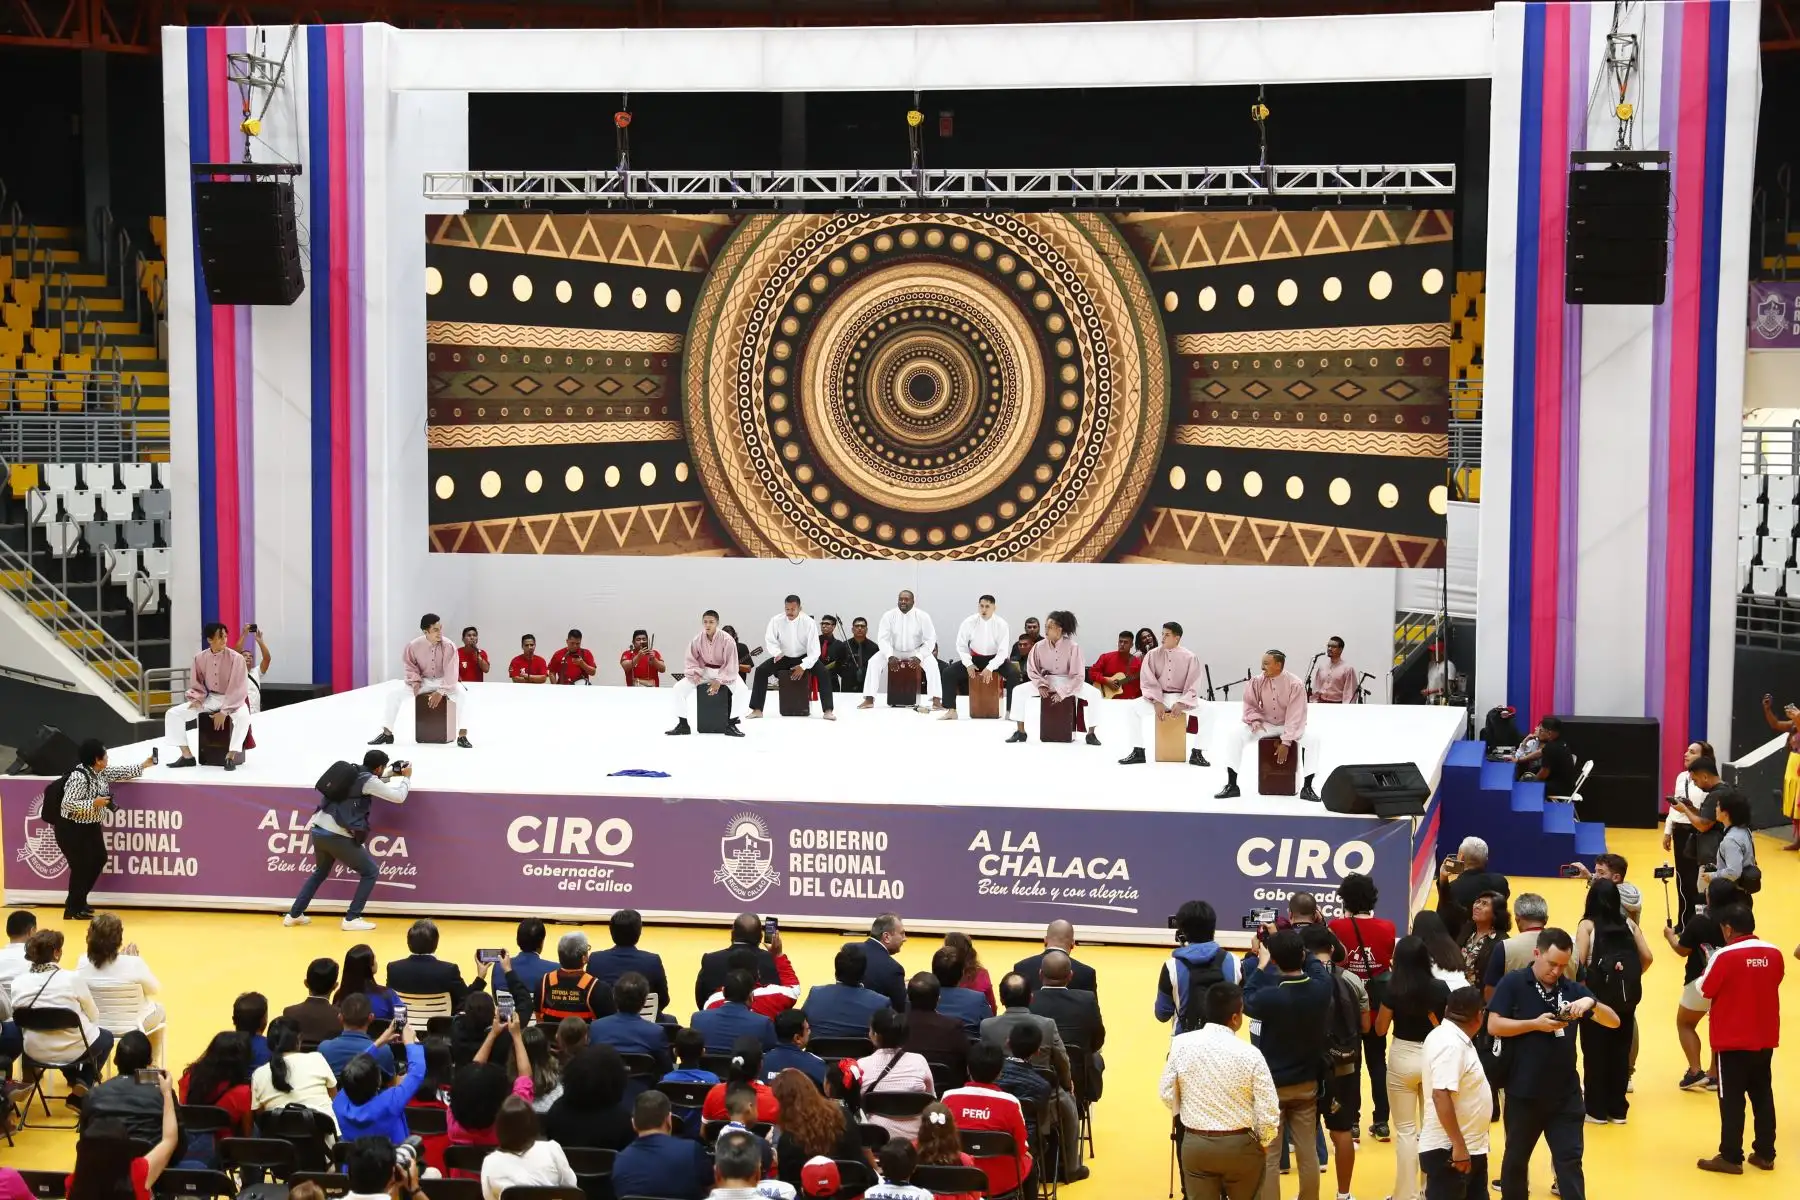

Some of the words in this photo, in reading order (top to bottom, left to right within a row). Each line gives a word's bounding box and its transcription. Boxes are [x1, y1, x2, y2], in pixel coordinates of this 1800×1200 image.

[103, 810, 182, 829] OBIERNO
[258, 809, 280, 830] A
[103, 832, 180, 853] EGIONAL
[268, 833, 409, 857] CHCA
[506, 815, 633, 856] CIRO
[789, 828, 888, 851] GOBIERNO
[967, 829, 992, 852] A
[1001, 830, 1041, 853] LA
[102, 855, 123, 874] EL
[128, 856, 198, 877] CALLAO
[267, 856, 296, 872] Bien
[298, 857, 317, 872] hec
[335, 864, 344, 878] y
[379, 861, 418, 880] legría
[789, 852, 886, 875] REGIONAL
[978, 853, 1130, 881] CHALACA
[1236, 836, 1375, 879] CIRO
[522, 864, 614, 878] Gobernador
[557, 879, 581, 891] del
[585, 879, 633, 893] Callao
[747, 880, 766, 897] CALLAO
[789, 876, 825, 897] DEL
[830, 877, 905, 900] CALLAO
[977, 878, 1009, 895] Bien
[1011, 879, 1047, 896] hecho
[1050, 885, 1061, 901] y
[1062, 886, 1086, 899] con
[1089, 883, 1140, 904] alegría
[1253, 888, 1344, 904] Gobeado
[1746, 956, 1768, 968] PERÚ
[962, 1107, 991, 1120] PERÚ
